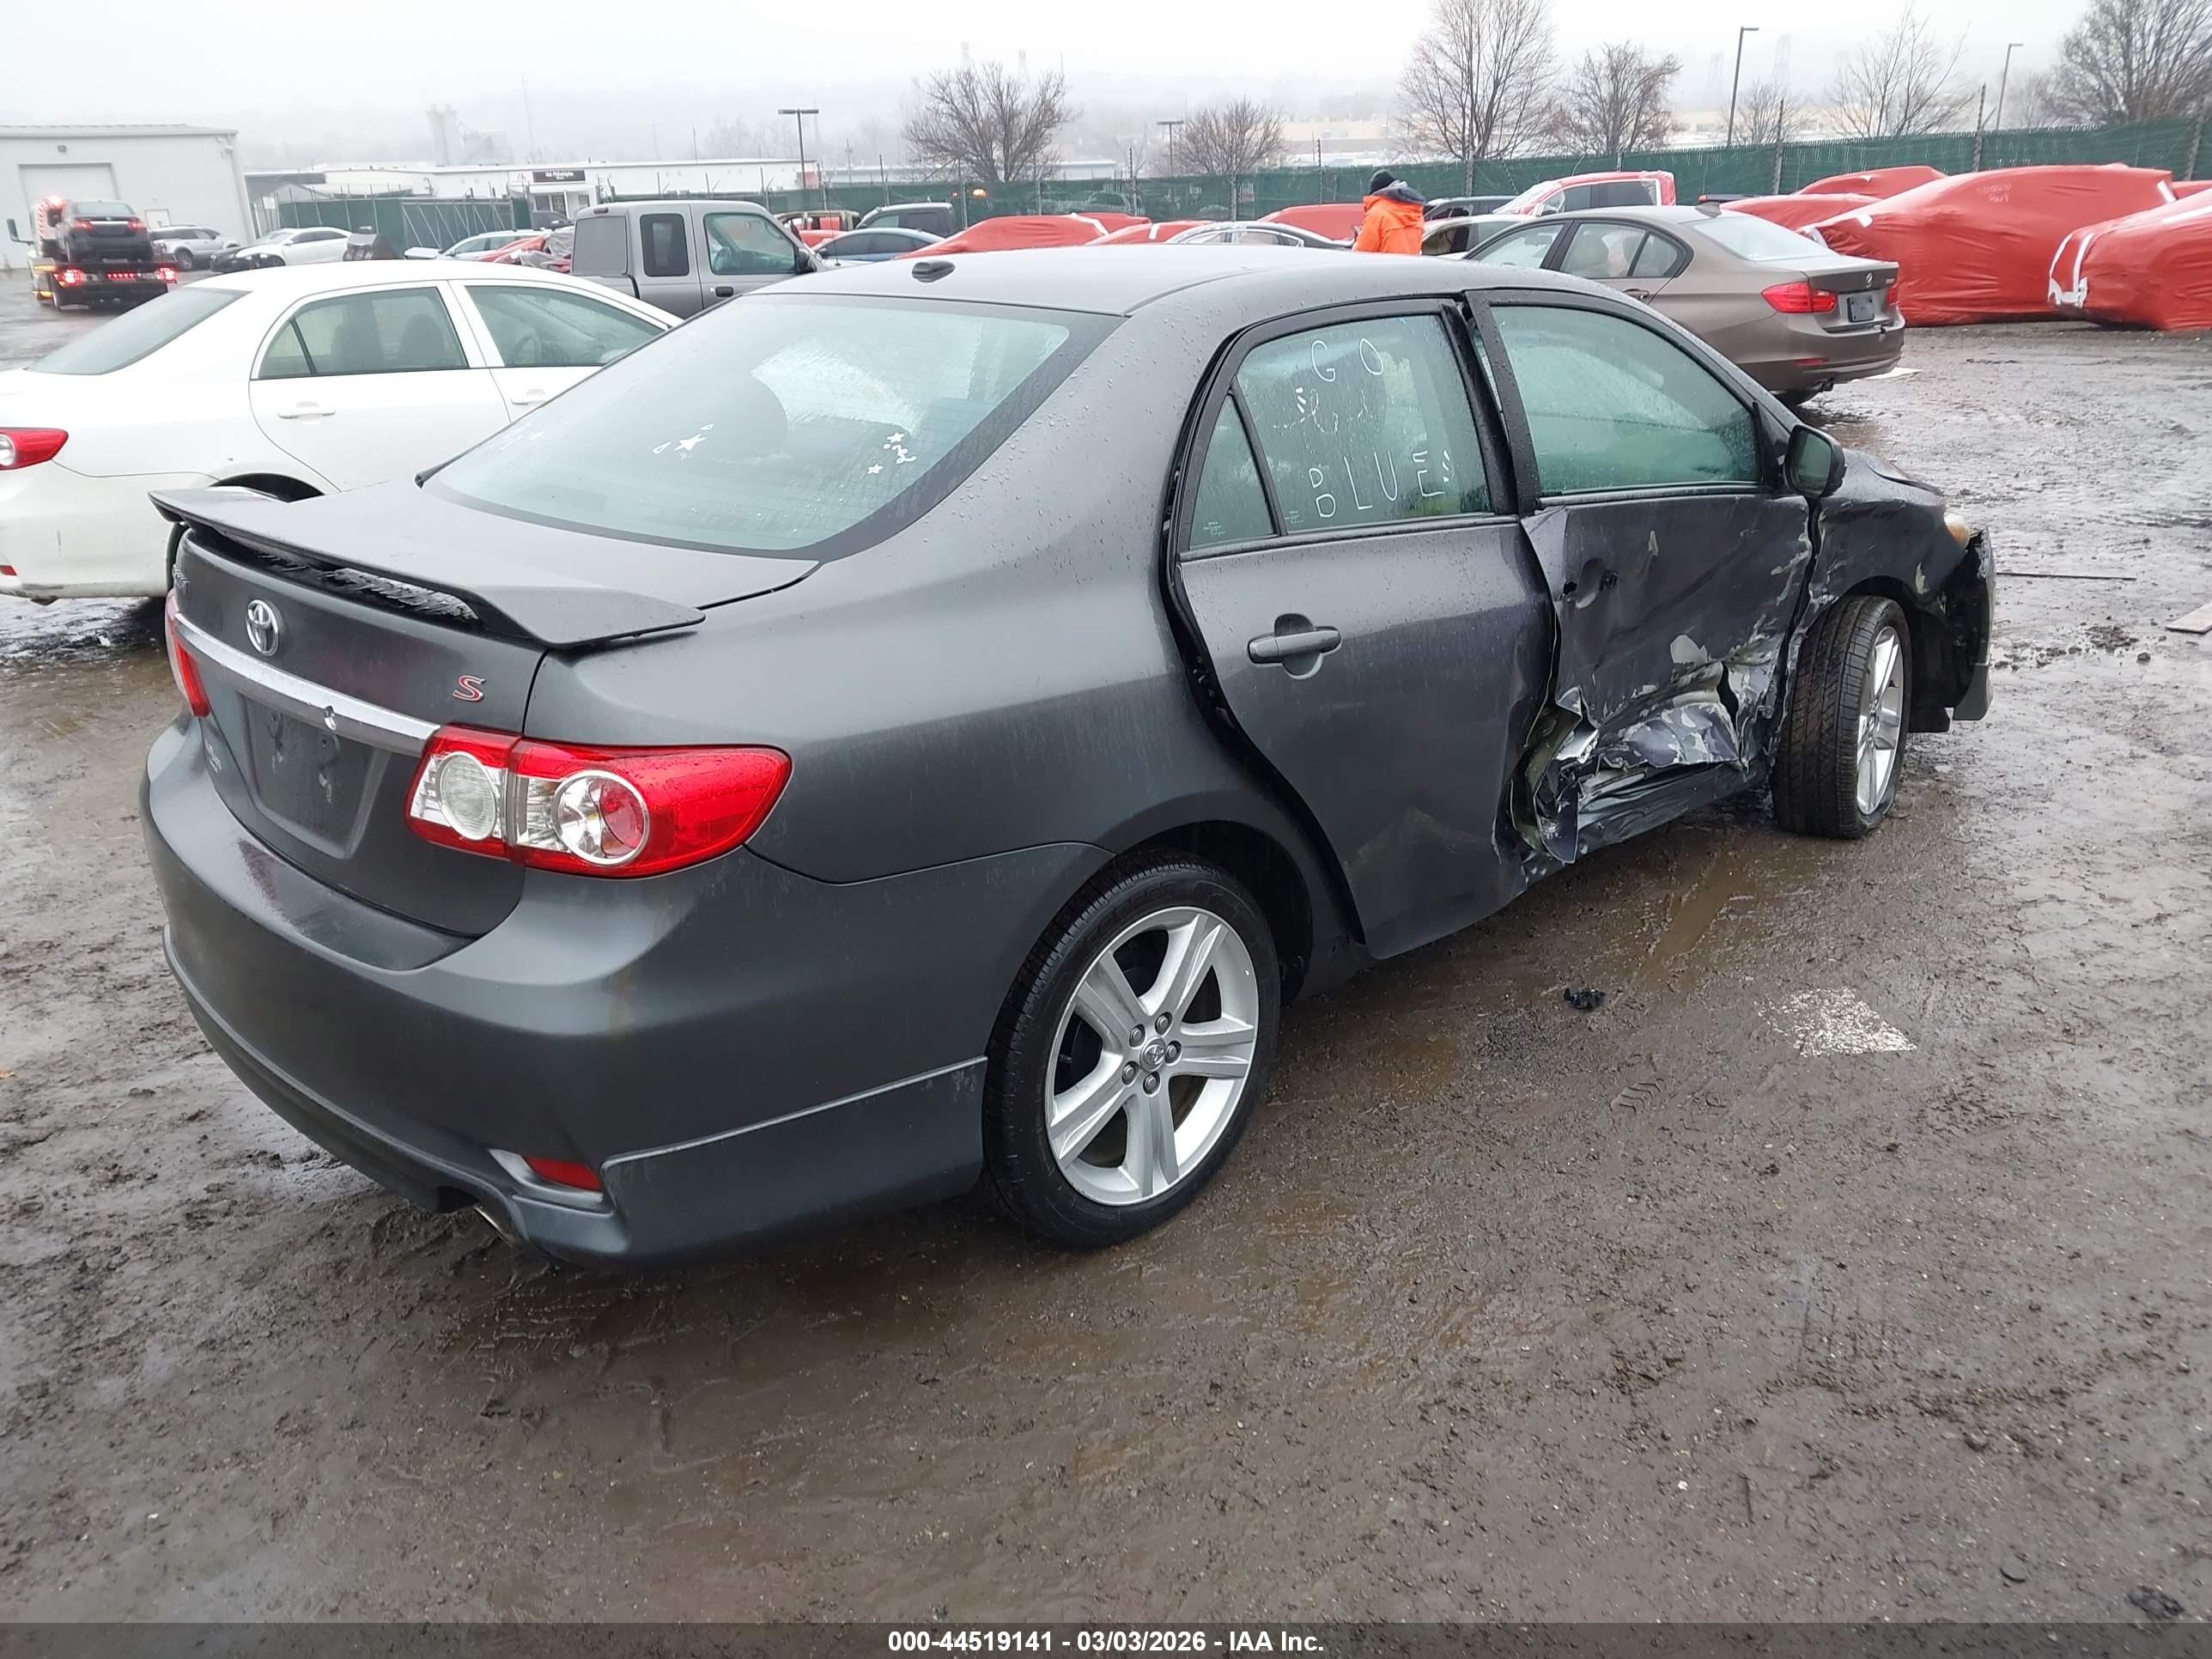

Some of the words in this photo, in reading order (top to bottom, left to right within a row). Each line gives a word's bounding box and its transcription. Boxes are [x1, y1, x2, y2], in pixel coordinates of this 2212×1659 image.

[1310, 338, 1384, 382] GO
[1309, 451, 1444, 518] BLUE
[453, 673, 486, 702] S
